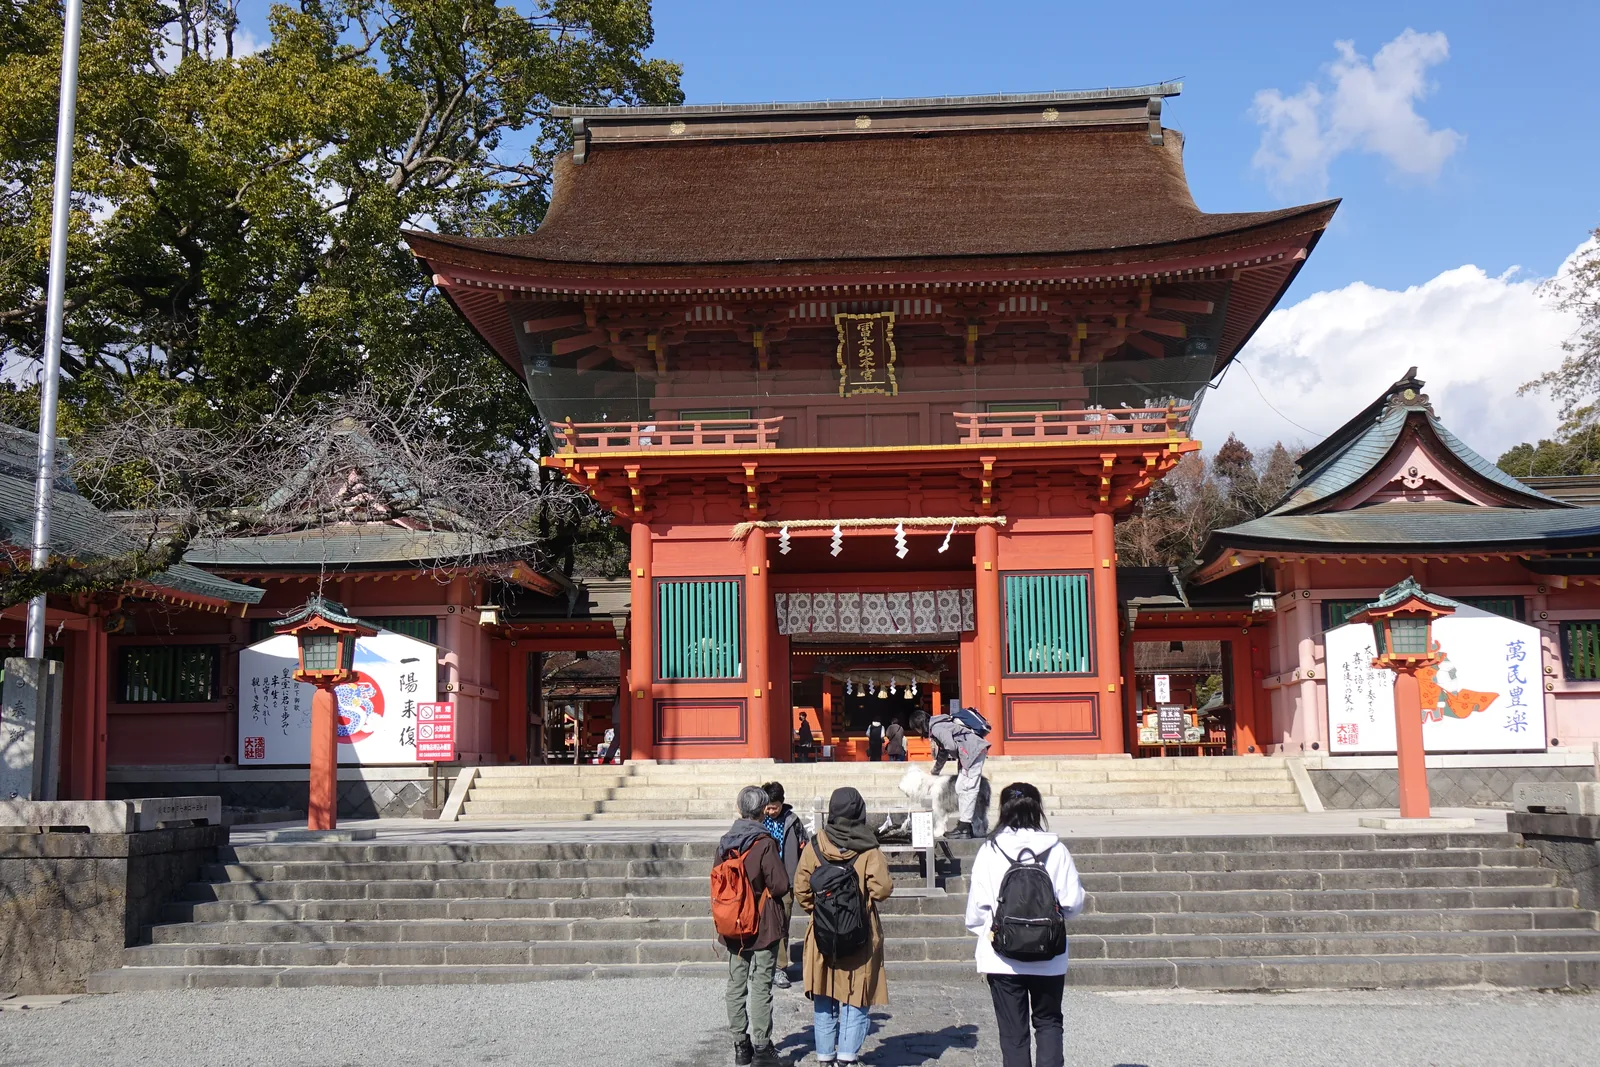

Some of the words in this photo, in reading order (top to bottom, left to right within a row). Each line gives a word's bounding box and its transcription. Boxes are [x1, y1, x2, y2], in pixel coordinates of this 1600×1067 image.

[9, 700, 26, 742] 奉納
[399, 657, 420, 748] 一陽来復
[1503, 640, 1528, 732] 萬民豊楽
